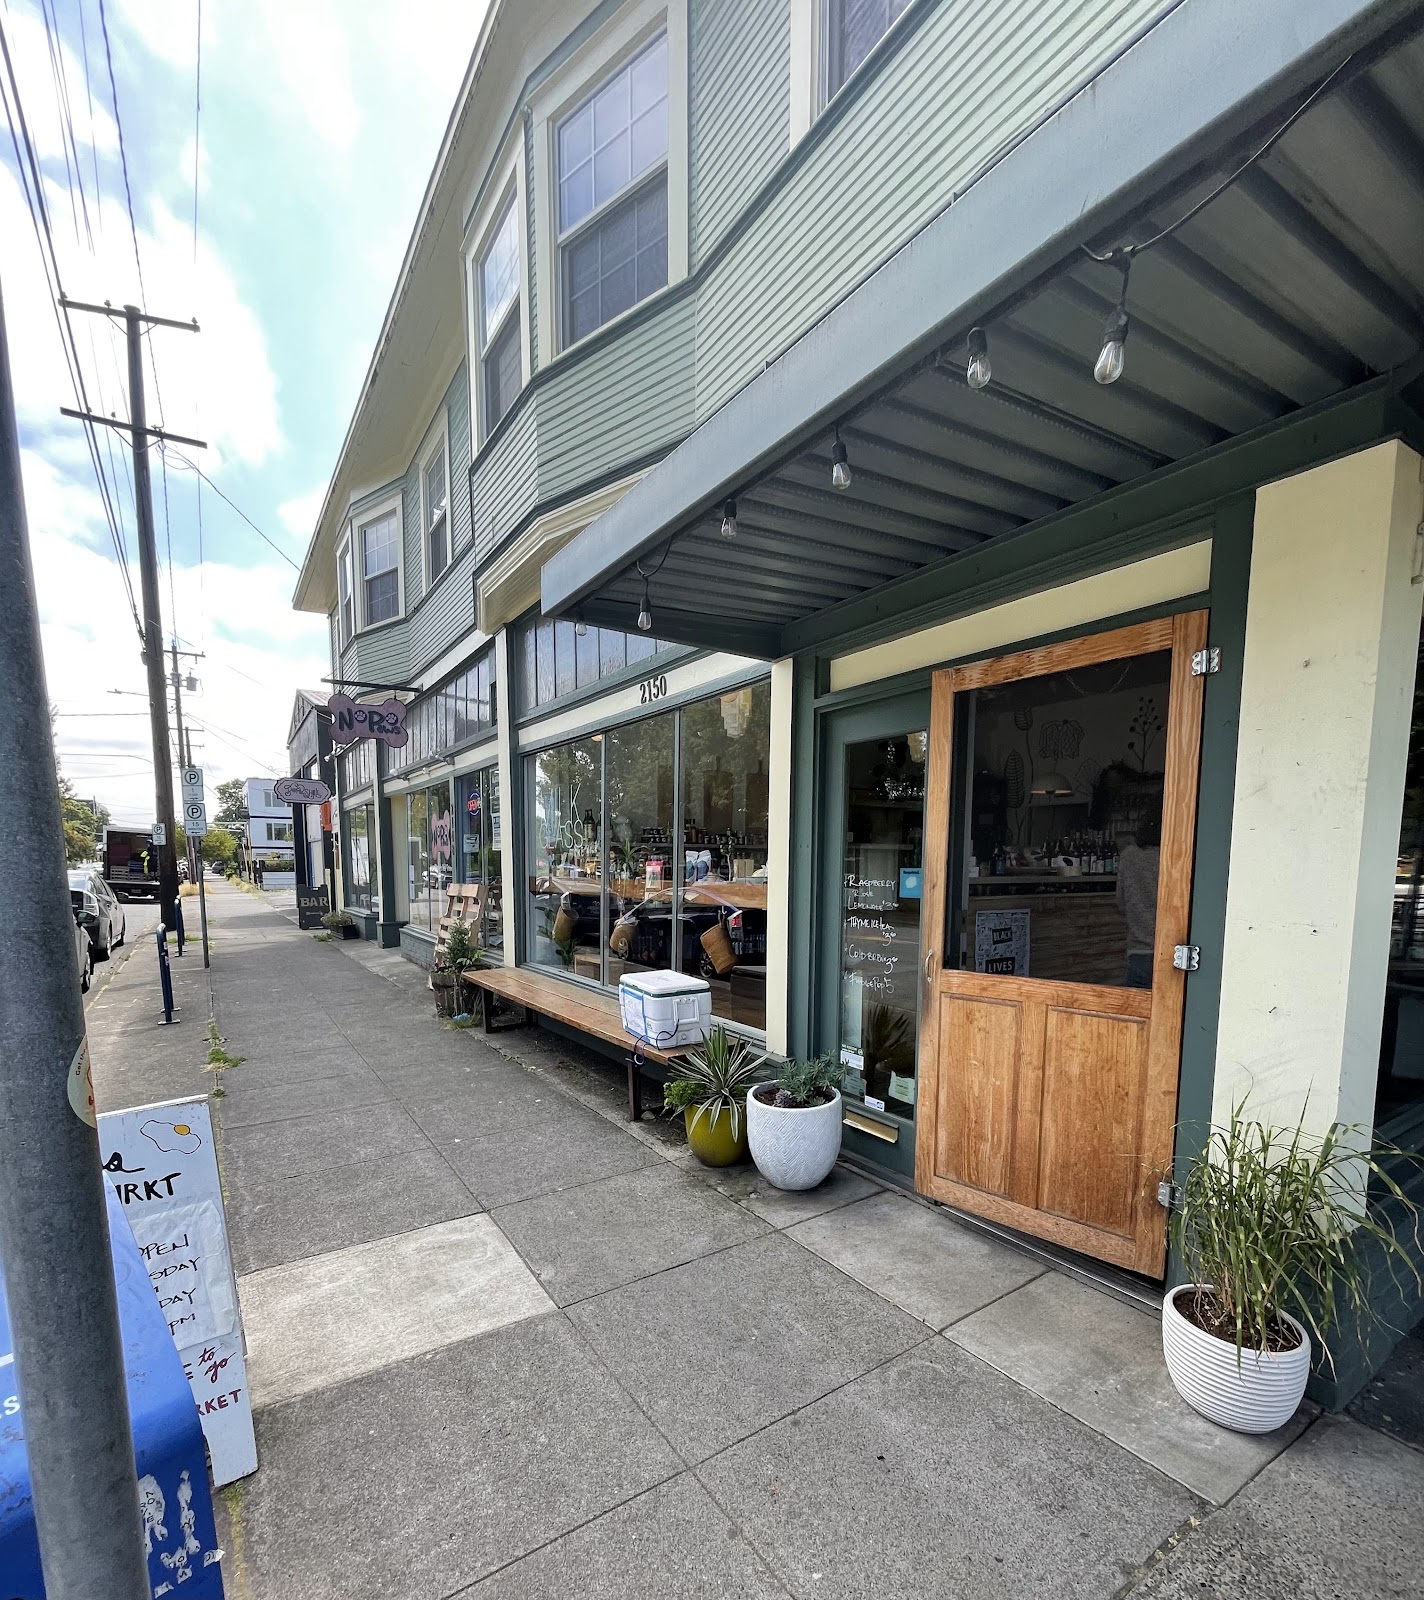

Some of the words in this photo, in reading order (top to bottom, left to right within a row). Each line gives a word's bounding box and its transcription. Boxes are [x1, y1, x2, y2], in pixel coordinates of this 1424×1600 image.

[639, 675, 667, 704] 2150
[300, 896, 328, 907] BAR
[988, 961, 1013, 972] LIVES
